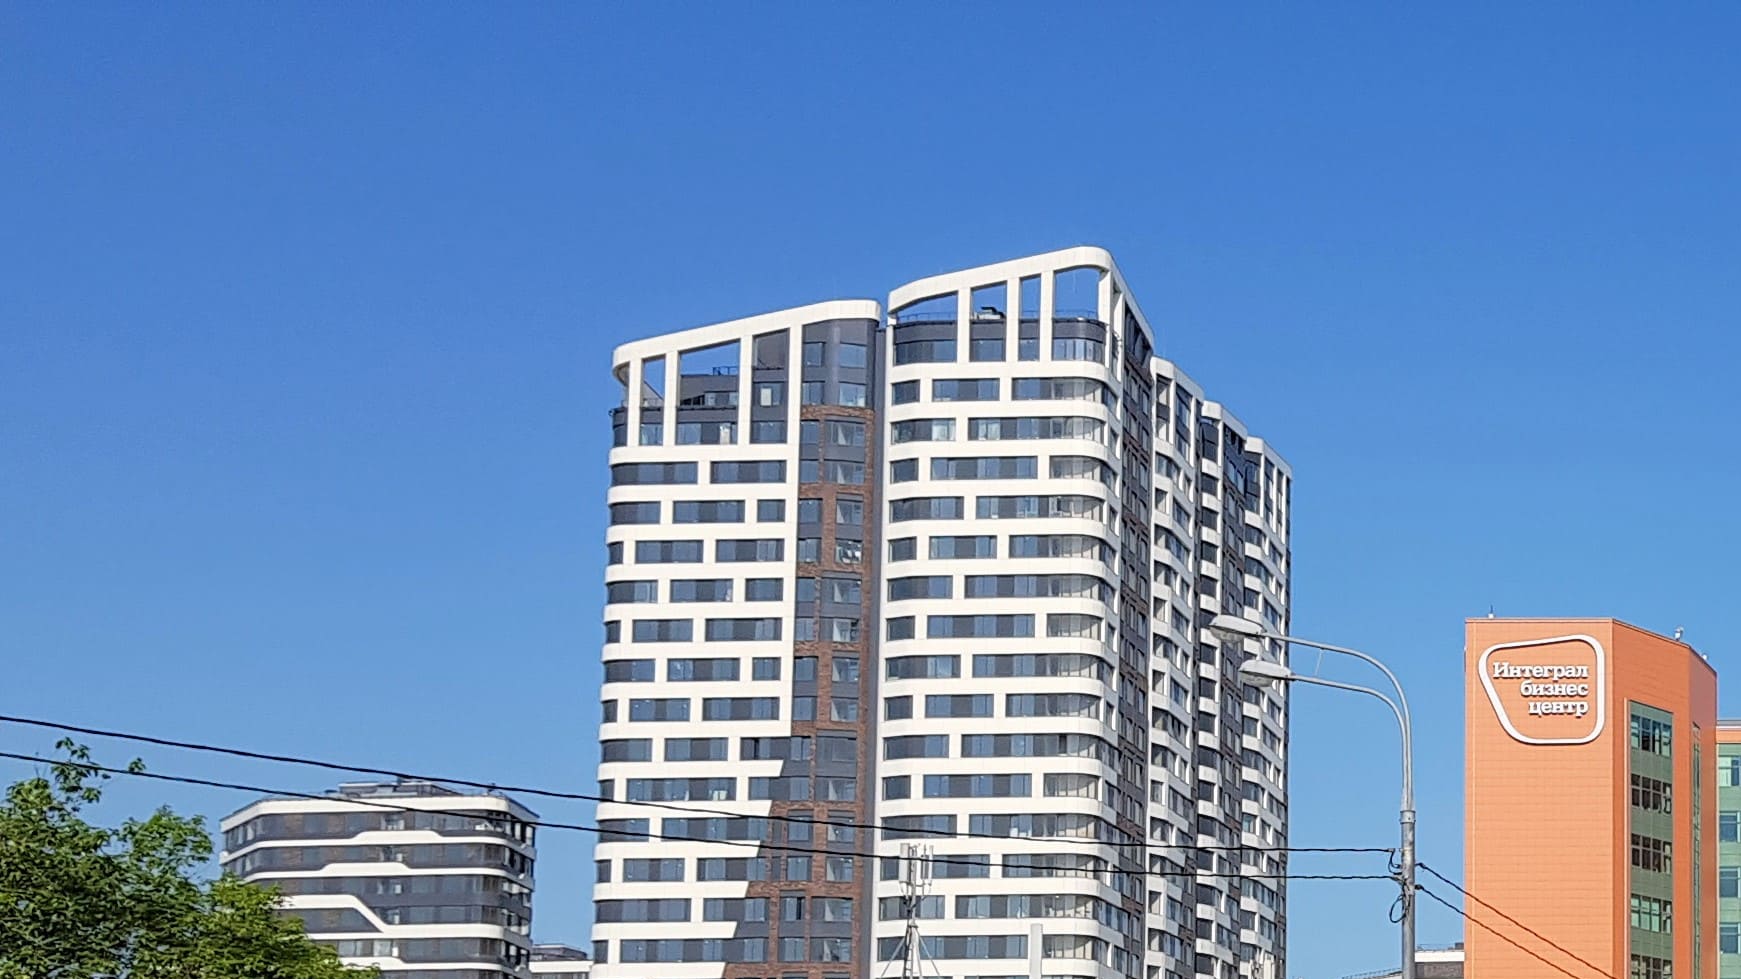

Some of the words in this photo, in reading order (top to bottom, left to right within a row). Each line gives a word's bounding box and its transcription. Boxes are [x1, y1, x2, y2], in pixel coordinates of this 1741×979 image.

[1492, 661, 1589, 682] Интеграл
[1520, 680, 1589, 698] бизнес
[1528, 701, 1589, 718] центр
